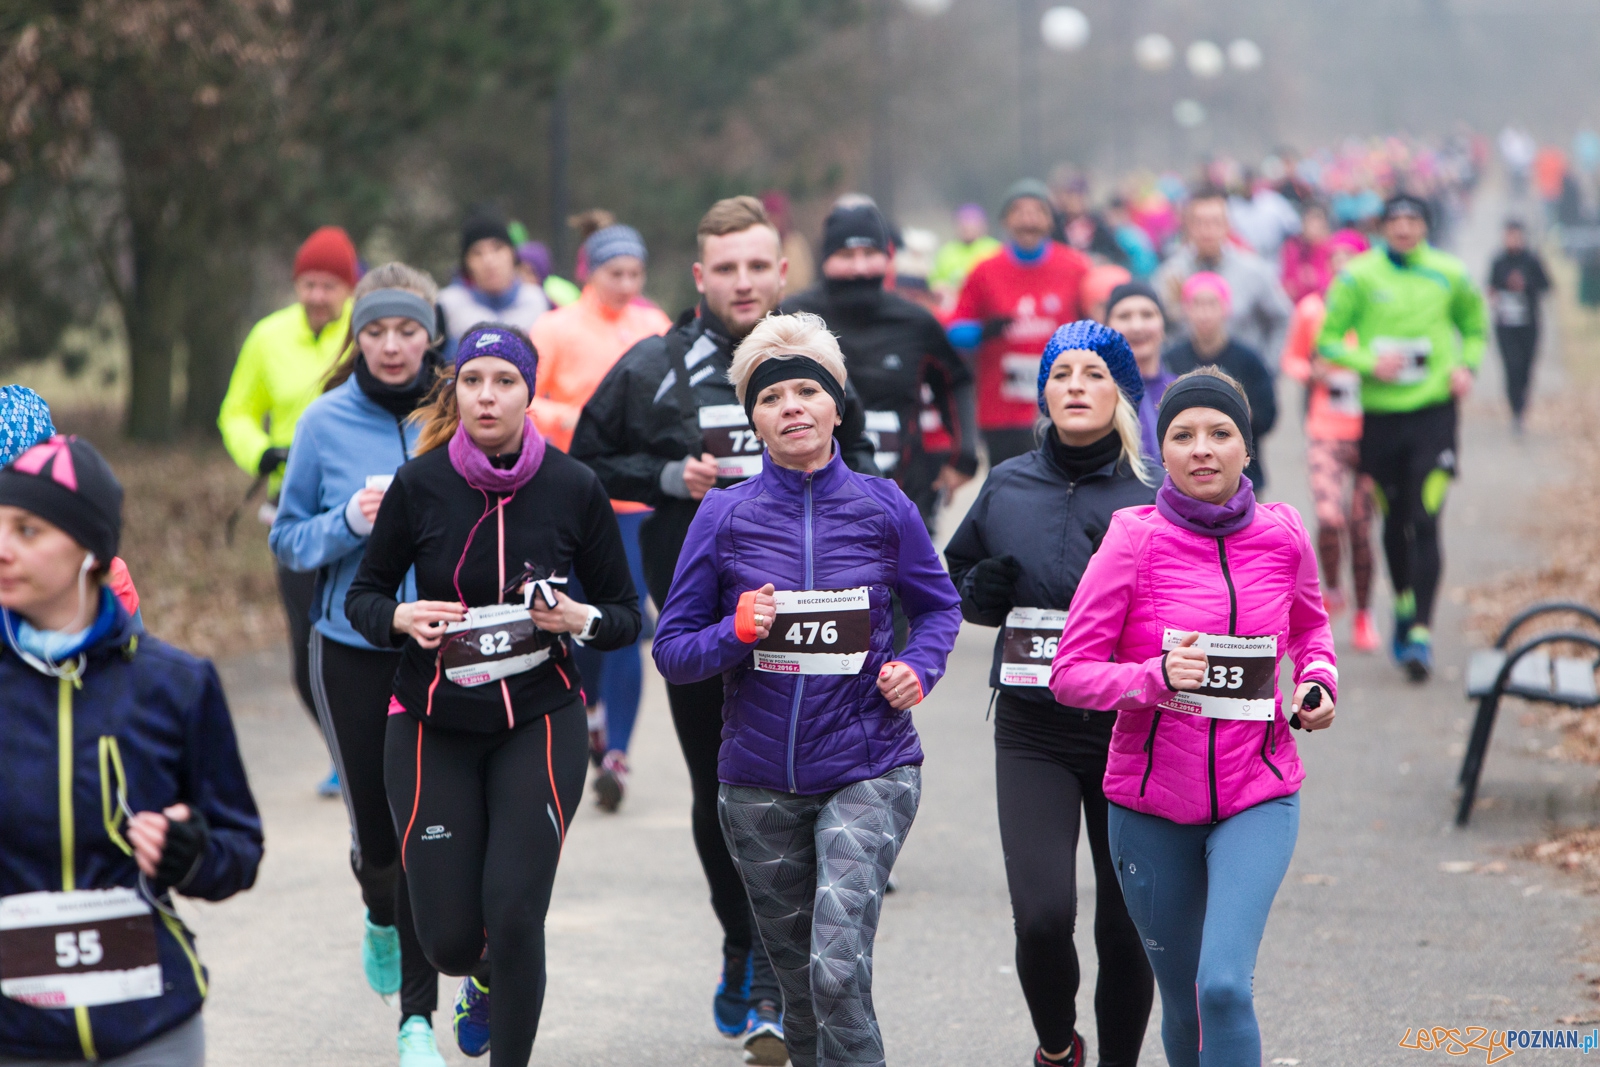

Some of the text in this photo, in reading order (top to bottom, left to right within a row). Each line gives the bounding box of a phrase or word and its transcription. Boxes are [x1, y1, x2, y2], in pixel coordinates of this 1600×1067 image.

[728, 429, 768, 453] 72
[797, 596, 865, 605] BIEGCZEKOLADOWY.PL
[479, 630, 512, 656] 82
[785, 621, 838, 644] 476
[1029, 636, 1062, 659] 36
[1210, 642, 1273, 650] BIEGCZEKOLADOWY.PL
[55, 929, 104, 968] 55
